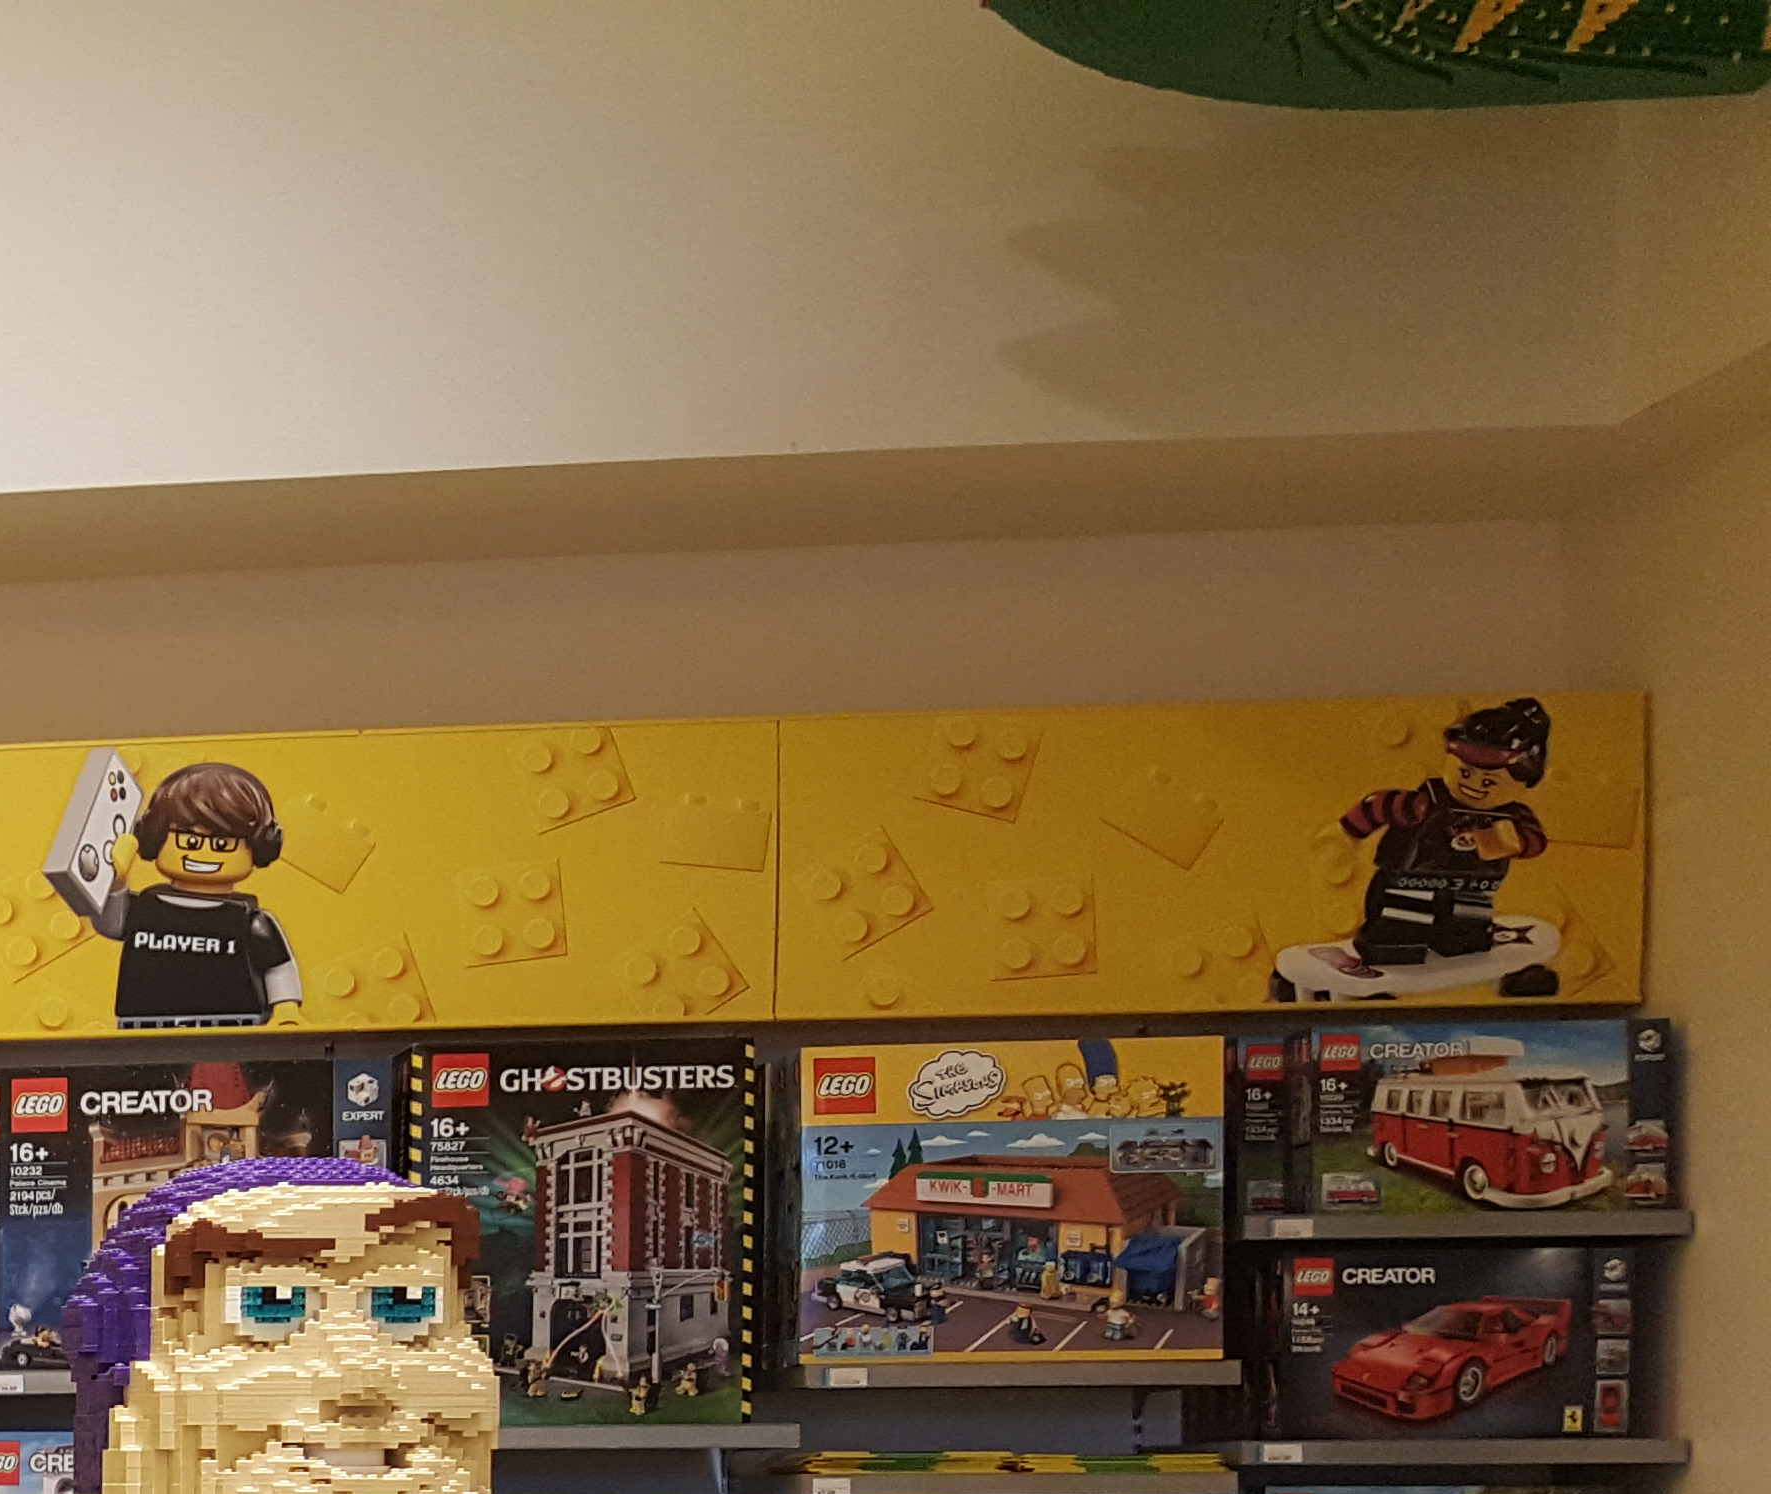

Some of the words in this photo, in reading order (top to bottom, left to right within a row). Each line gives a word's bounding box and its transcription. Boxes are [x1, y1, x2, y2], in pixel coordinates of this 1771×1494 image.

[134, 931, 220, 954] PLAYER
[226, 940, 236, 954] 1
[1322, 1044, 1358, 1060] LEGO
[1369, 1041, 1464, 1060] CREATOR
[1247, 1055, 1282, 1071] LEGO
[434, 1067, 489, 1094] LEGO
[817, 1074, 873, 1098] LEGO
[12, 1092, 66, 1117] LEGO
[79, 1088, 213, 1116] CREATOR
[341, 1110, 385, 1122] EXPERT
[430, 1116, 471, 1138] 16+
[9, 1142, 49, 1163] 16+
[429, 1141, 466, 1152] 75827
[813, 1135, 854, 1156] 12+
[9, 1165, 43, 1177] 10232
[1293, 1268, 1331, 1284] LEGO
[1341, 1266, 1437, 1286] CREATOR
[1292, 1302, 1321, 1316] 14+
